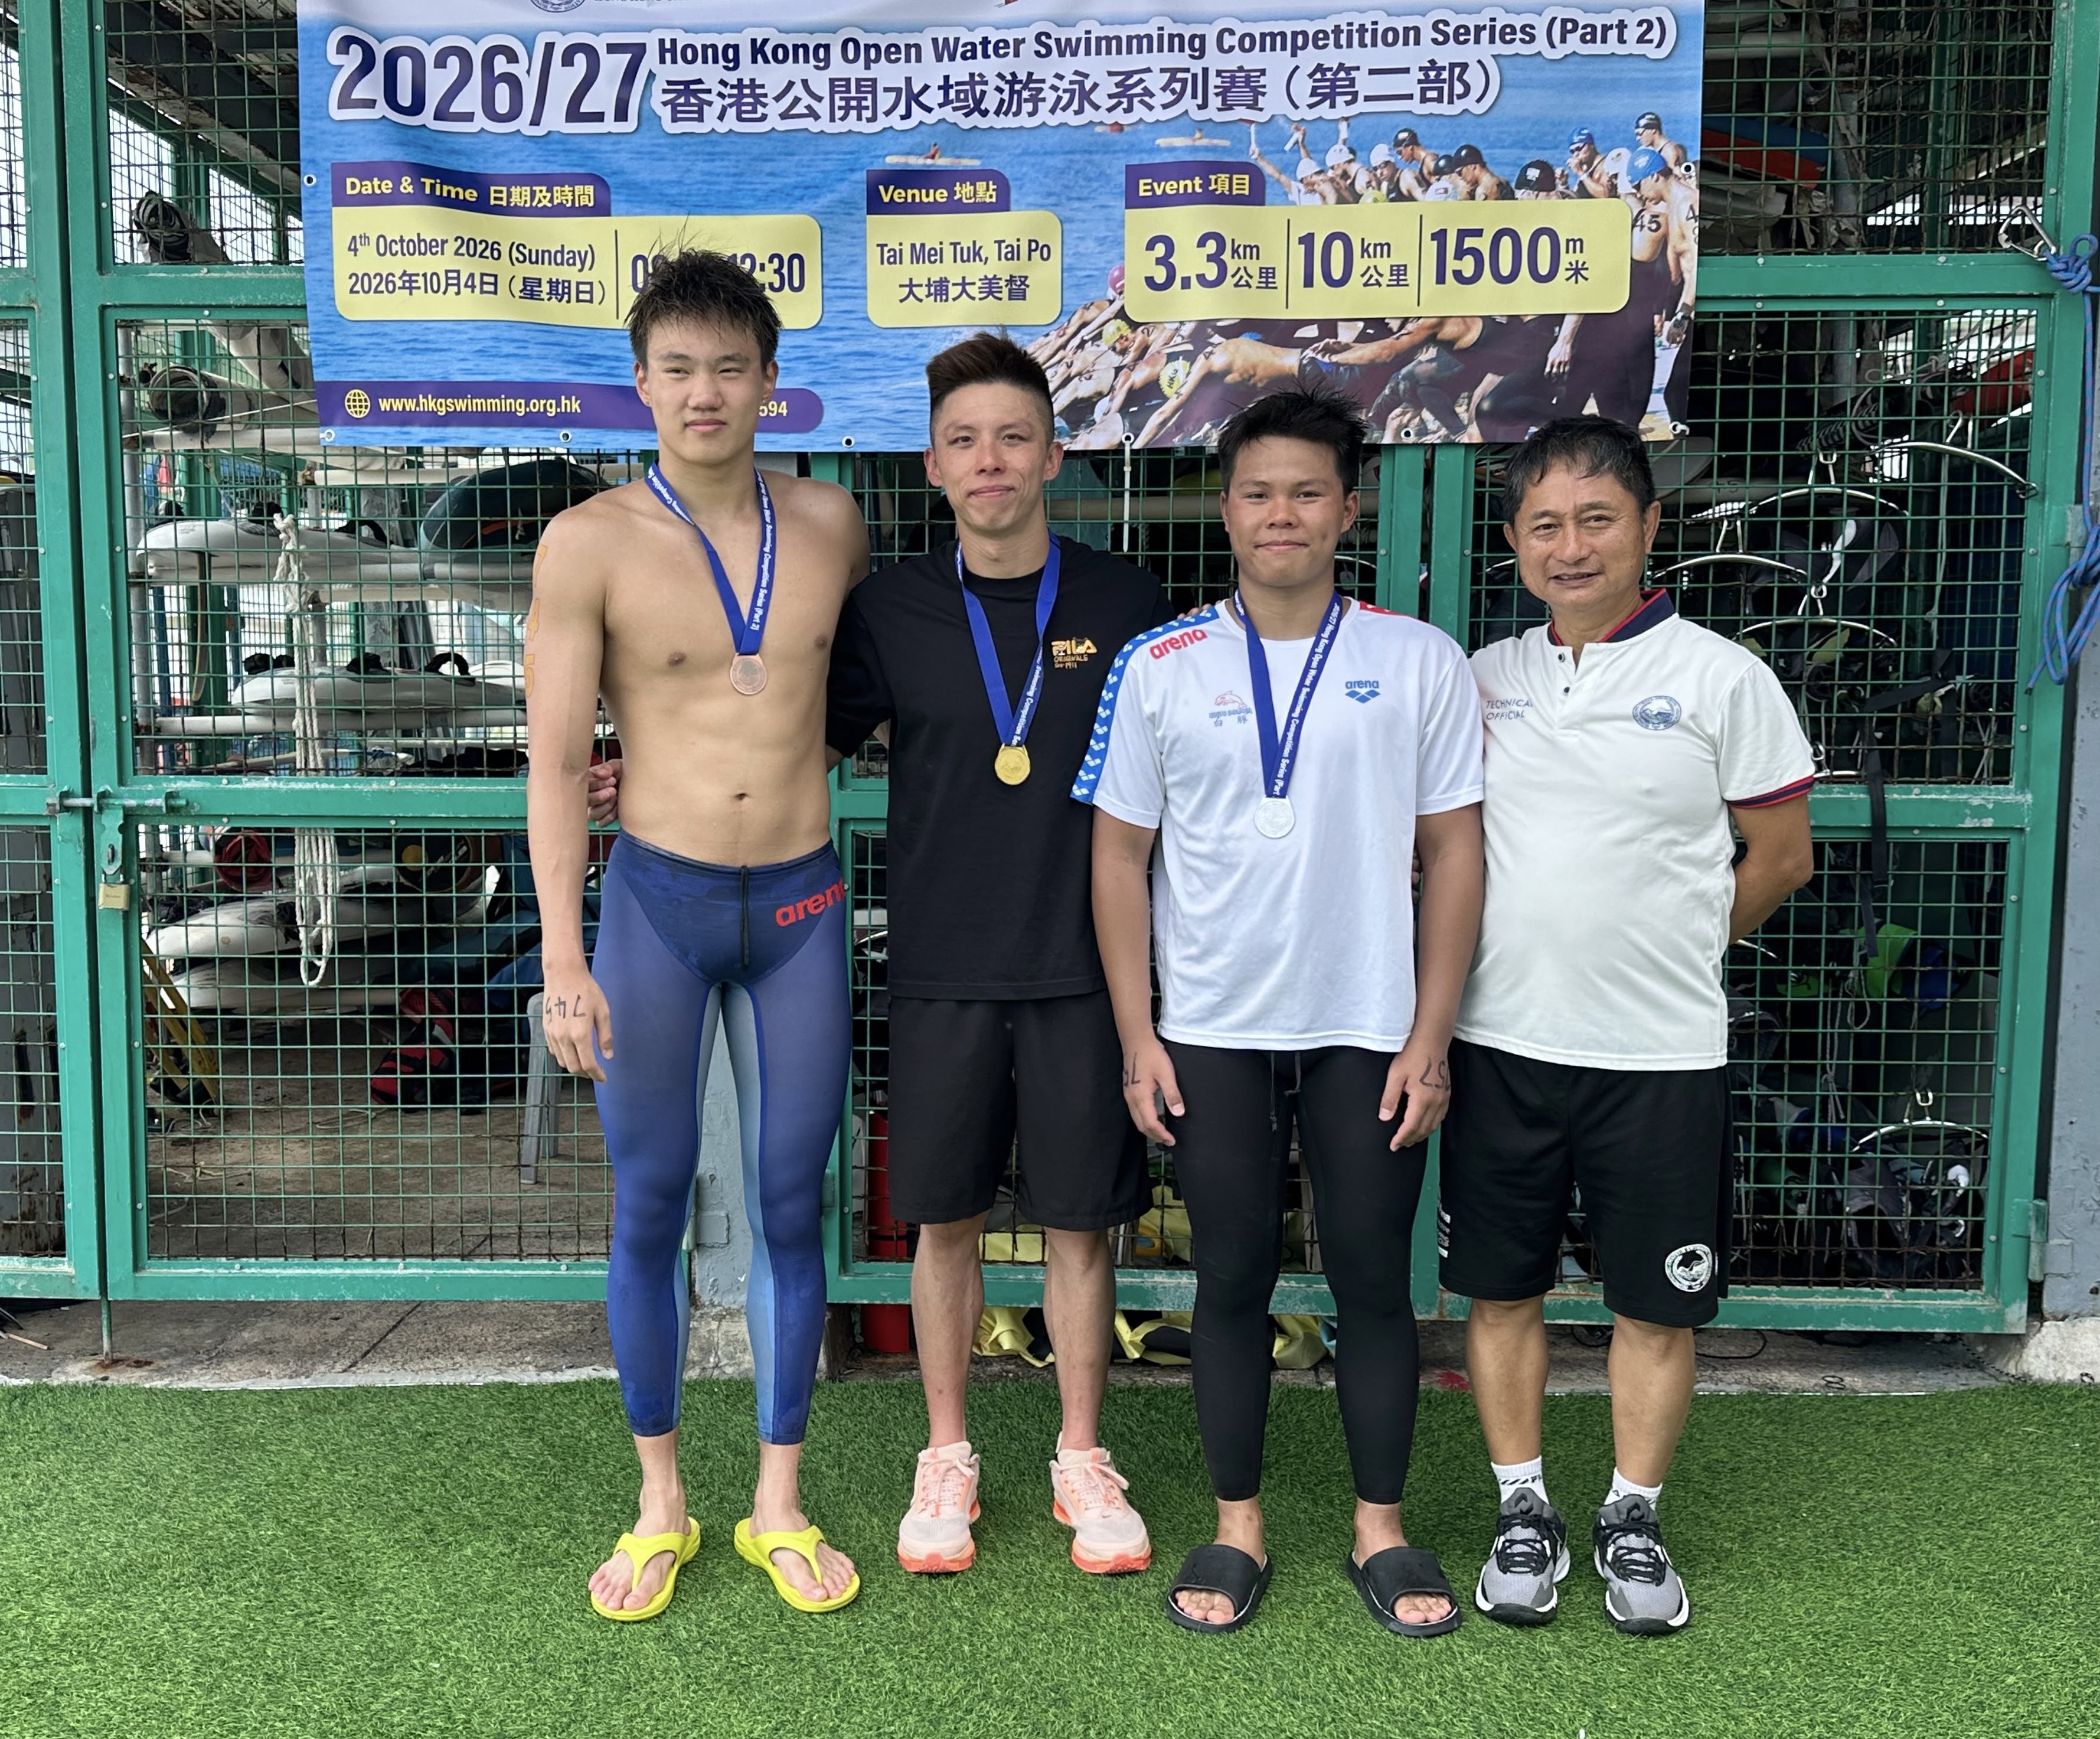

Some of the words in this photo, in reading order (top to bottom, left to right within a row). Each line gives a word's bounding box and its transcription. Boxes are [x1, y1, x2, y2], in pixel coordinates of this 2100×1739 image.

[658, 38, 740, 71] Hong
[750, 37, 831, 70] Kong
[841, 37, 922, 70] Open
[931, 35, 1026, 63] Water
[1034, 27, 1206, 60] Swimming
[1216, 21, 1421, 58] Competition
[1431, 17, 1536, 46] Series
[1546, 17, 1628, 48] (Part
[1635, 17, 1667, 49] 2)
[335, 34, 646, 126] 2026/27
[345, 177, 392, 195] Date
[399, 176, 414, 194] &
[420, 177, 478, 201] Time
[489, 185, 595, 207] 日期及時間
[878, 185, 948, 203] Venue
[953, 181, 997, 204] 地點
[1138, 177, 1202, 197] Event
[1209, 174, 1250, 196] 項目
[348, 233, 370, 257] 4th
[375, 233, 448, 257] October
[454, 236, 502, 260] 2026
[508, 241, 596, 272] (Sunday)
[876, 242, 903, 266] Tai
[910, 241, 943, 265] Mei
[949, 240, 989, 266] Tuk,
[994, 238, 1021, 262] Tai
[1027, 239, 1051, 262] Po
[1144, 230, 1228, 292] 3.3
[1230, 238, 1260, 260] km
[1298, 231, 1354, 289] 10
[1360, 237, 1392, 260] km
[1430, 226, 1561, 286] 1500
[1565, 237, 1584, 255] m
[1230, 266, 1278, 291] 公里
[1359, 263, 1410, 288] 公里
[1564, 259, 1589, 285] 米
[898, 273, 1030, 304] 大埔大美督
[378, 394, 582, 416] www.hkgswimming.org.hk
[1149, 629, 1209, 660] arena
[1345, 680, 1380, 690] arena
[1486, 699, 1534, 709] TECHNICAL
[1486, 710, 1525, 720] OFFICIAL
